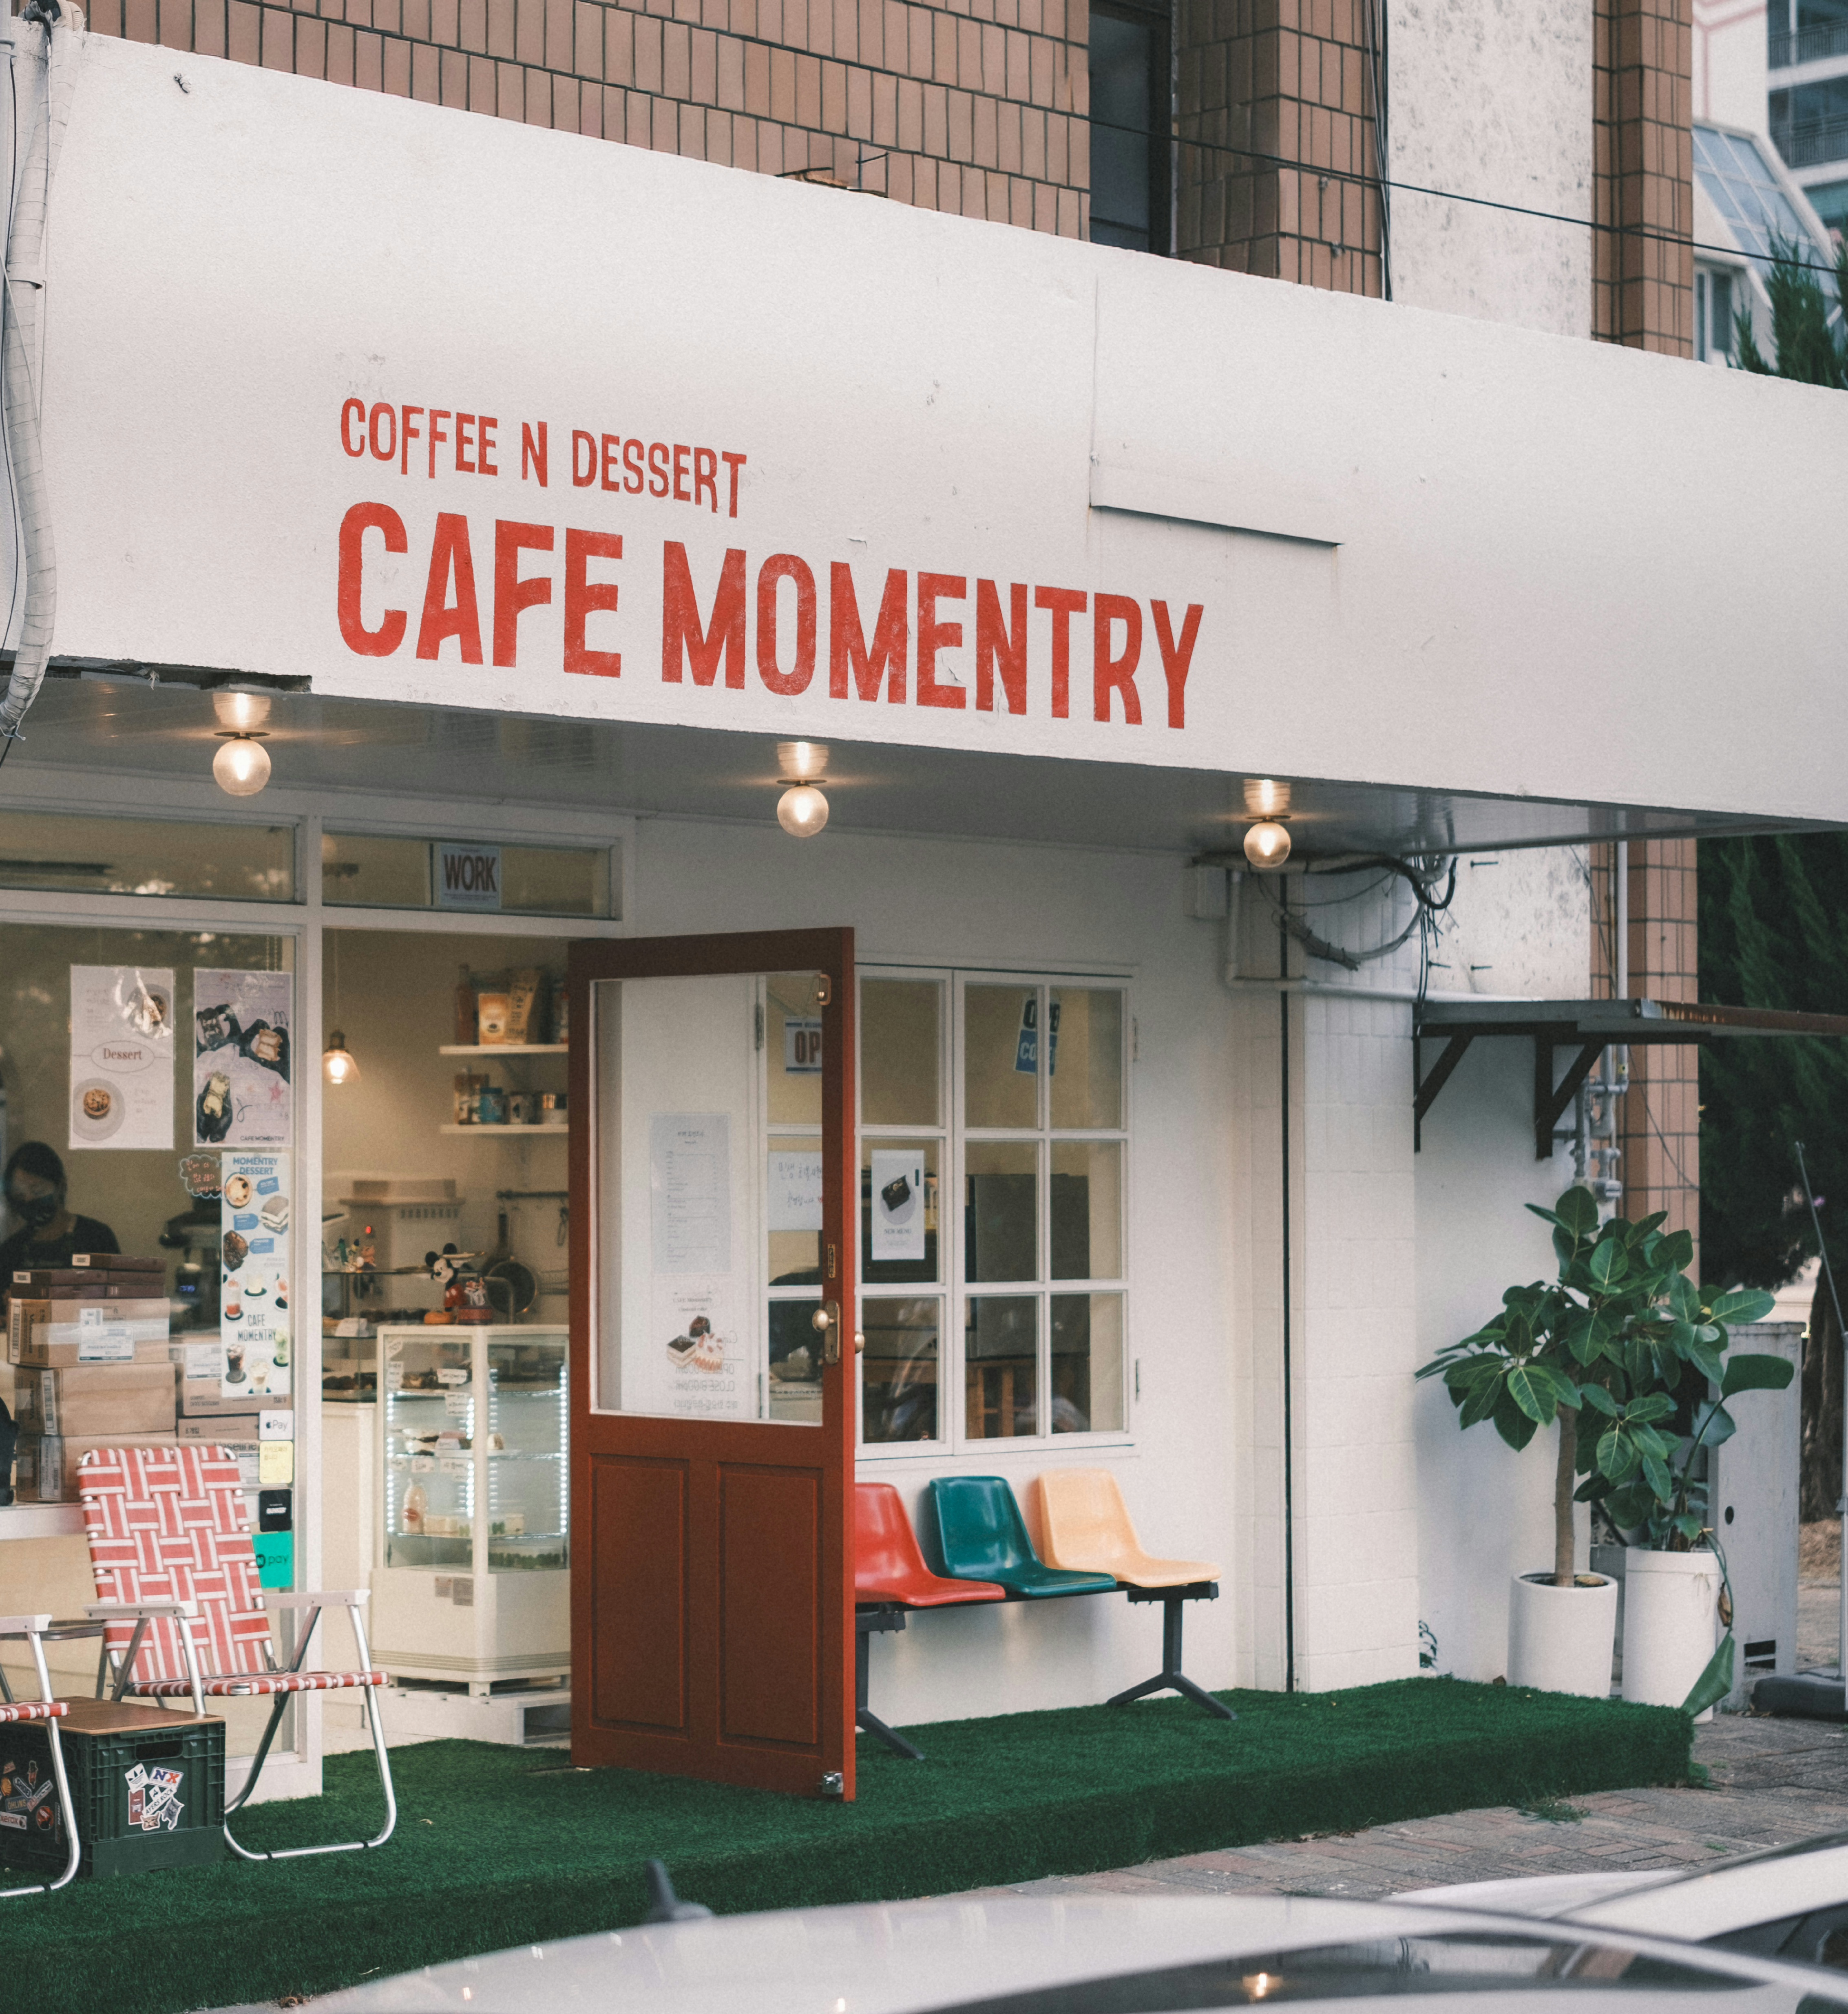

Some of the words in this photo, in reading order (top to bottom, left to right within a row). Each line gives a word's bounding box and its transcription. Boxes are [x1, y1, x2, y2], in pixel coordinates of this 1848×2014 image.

[341, 398, 498, 479] COFFEE
[522, 421, 548, 487] N
[572, 430, 747, 518] DESSERT
[338, 501, 623, 678] CAFE
[662, 541, 1204, 729] MOMENTRY
[444, 854, 497, 892] WORK
[103, 1047, 142, 1060] Dessert
[233, 1157, 278, 1166] MOMENTRY
[239, 1167, 274, 1175] DESSERT
[248, 1314, 265, 1326] CAFE
[238, 1328, 276, 1342] MOMENTRY
[273, 1420, 288, 1431] Pay
[268, 1553, 288, 1567] pay
[153, 1769, 179, 1784] NX
